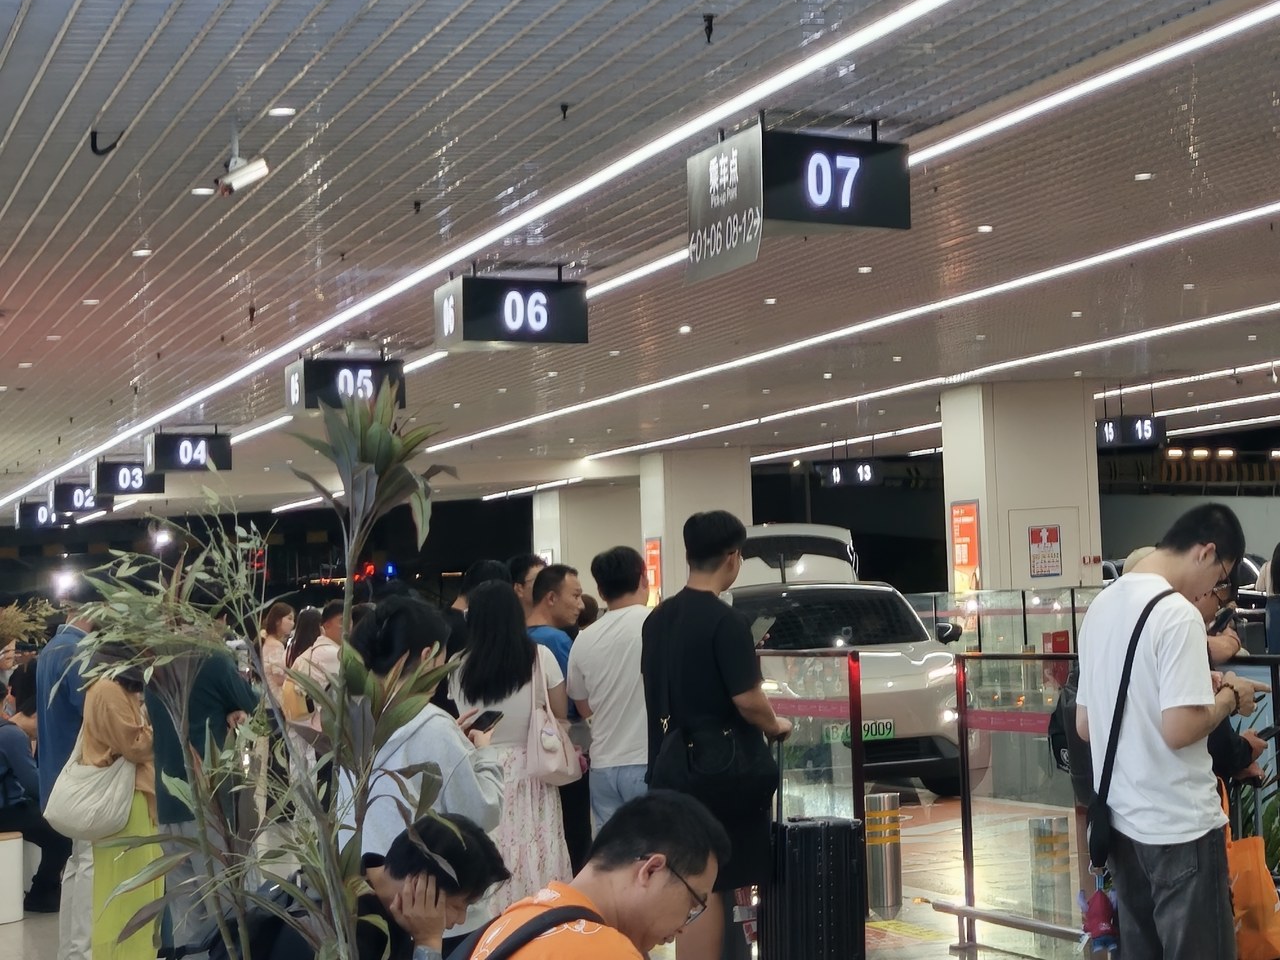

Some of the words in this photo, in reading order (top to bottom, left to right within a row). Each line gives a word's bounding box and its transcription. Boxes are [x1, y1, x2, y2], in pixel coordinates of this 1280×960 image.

[709, 147, 738, 194] 乘车点
[807, 152, 860, 208] 07
[503, 290, 548, 331] 06
[338, 368, 374, 400] 05
[1135, 419, 1152, 440] 15
[179, 440, 207, 465] 04
[118, 468, 143, 489] 03
[73, 488, 95, 508] 02
